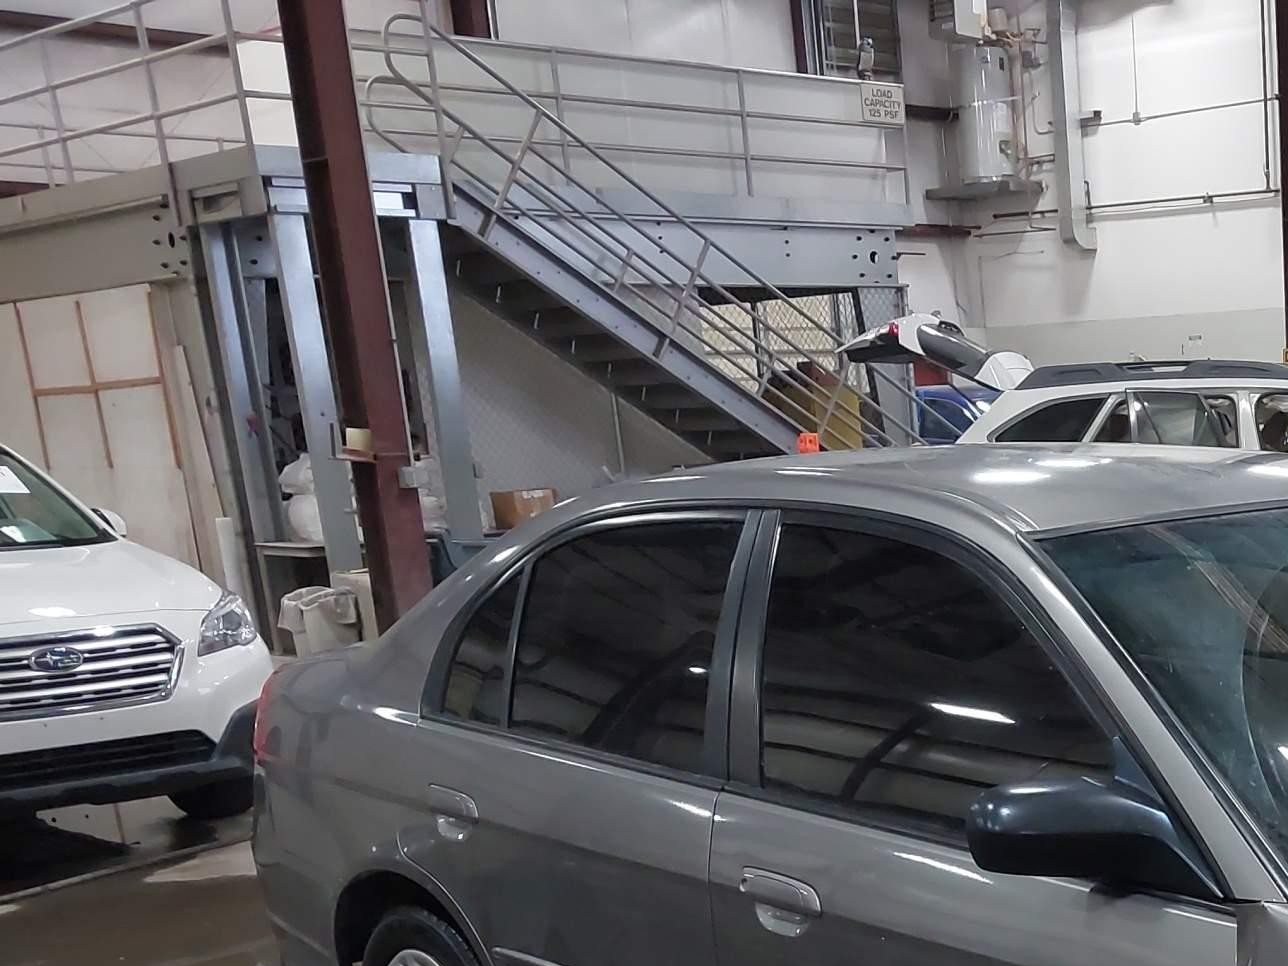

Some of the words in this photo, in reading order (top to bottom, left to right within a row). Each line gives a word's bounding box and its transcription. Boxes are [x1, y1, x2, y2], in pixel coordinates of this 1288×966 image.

[871, 88, 893, 99] LOAD
[864, 97, 901, 110] CAPACITY
[869, 109, 882, 118] 125
[884, 110, 899, 119] PSF
